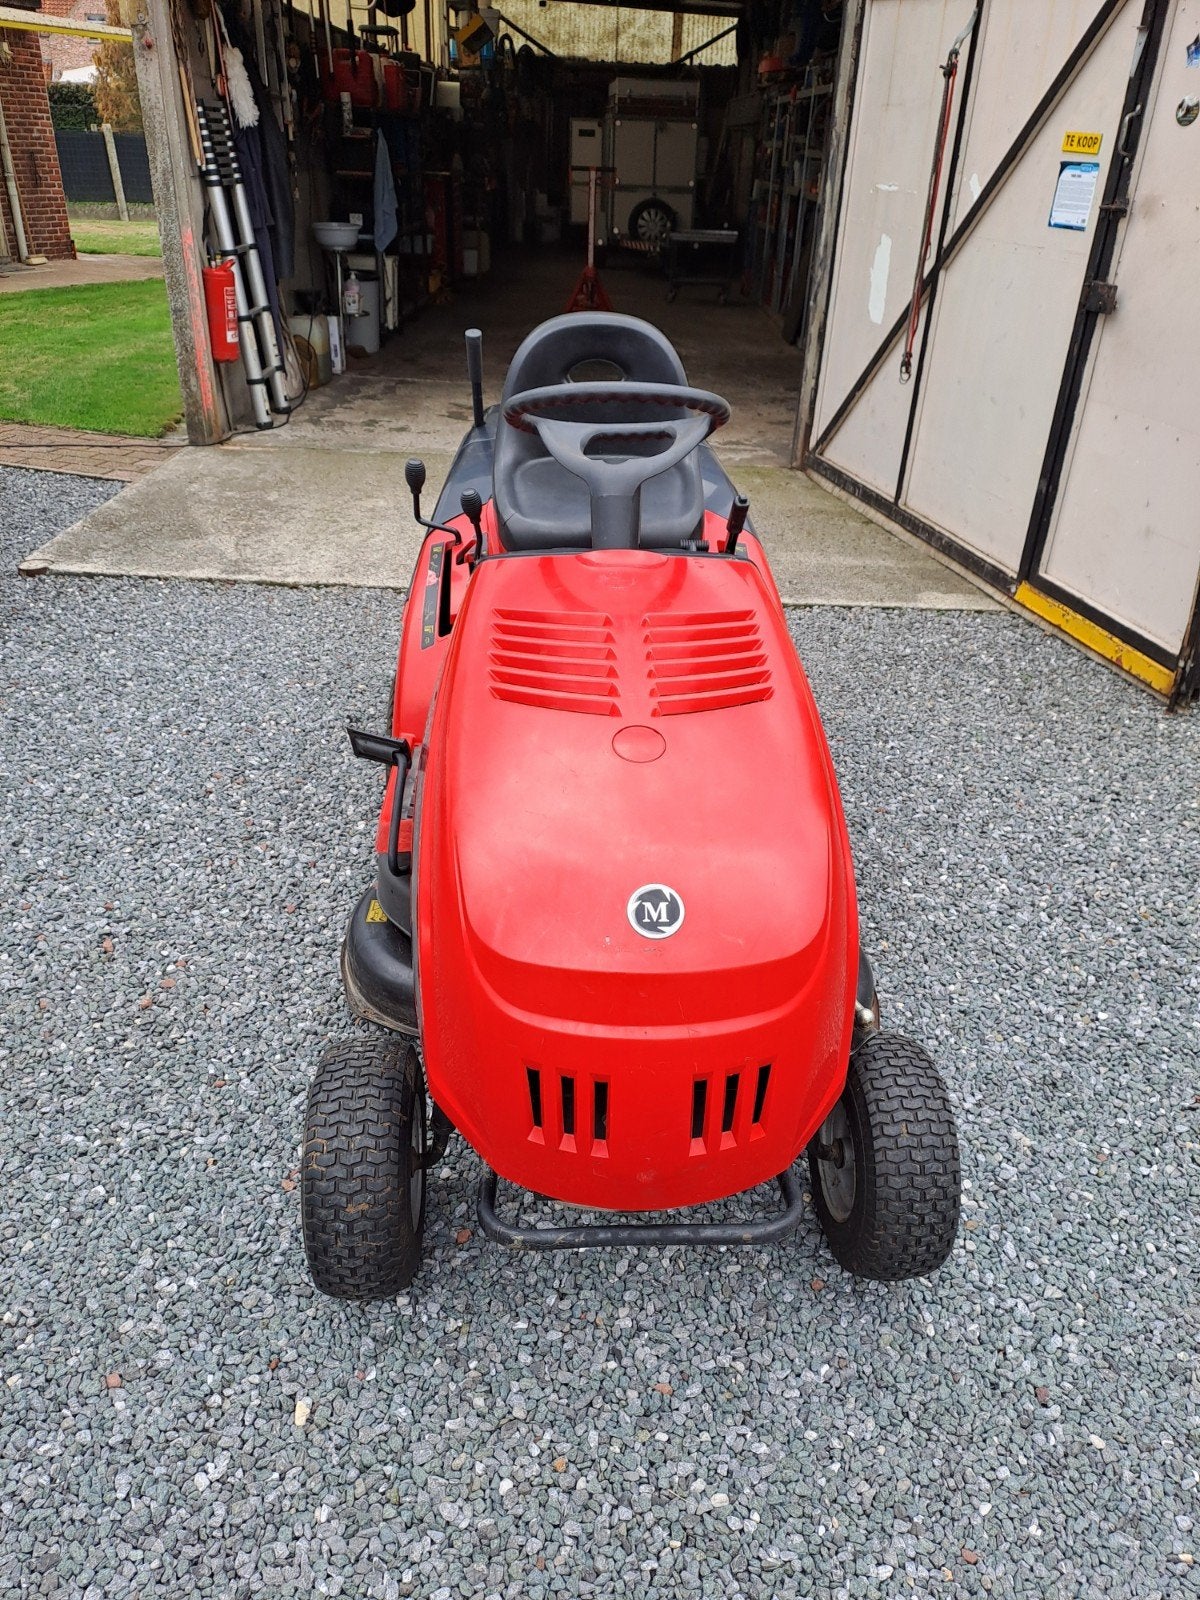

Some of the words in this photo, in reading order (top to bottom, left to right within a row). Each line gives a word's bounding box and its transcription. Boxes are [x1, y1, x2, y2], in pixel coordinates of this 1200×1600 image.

[1065, 134, 1075, 147] TE
[1077, 135, 1099, 148] KOOP
[642, 902, 670, 923] M
